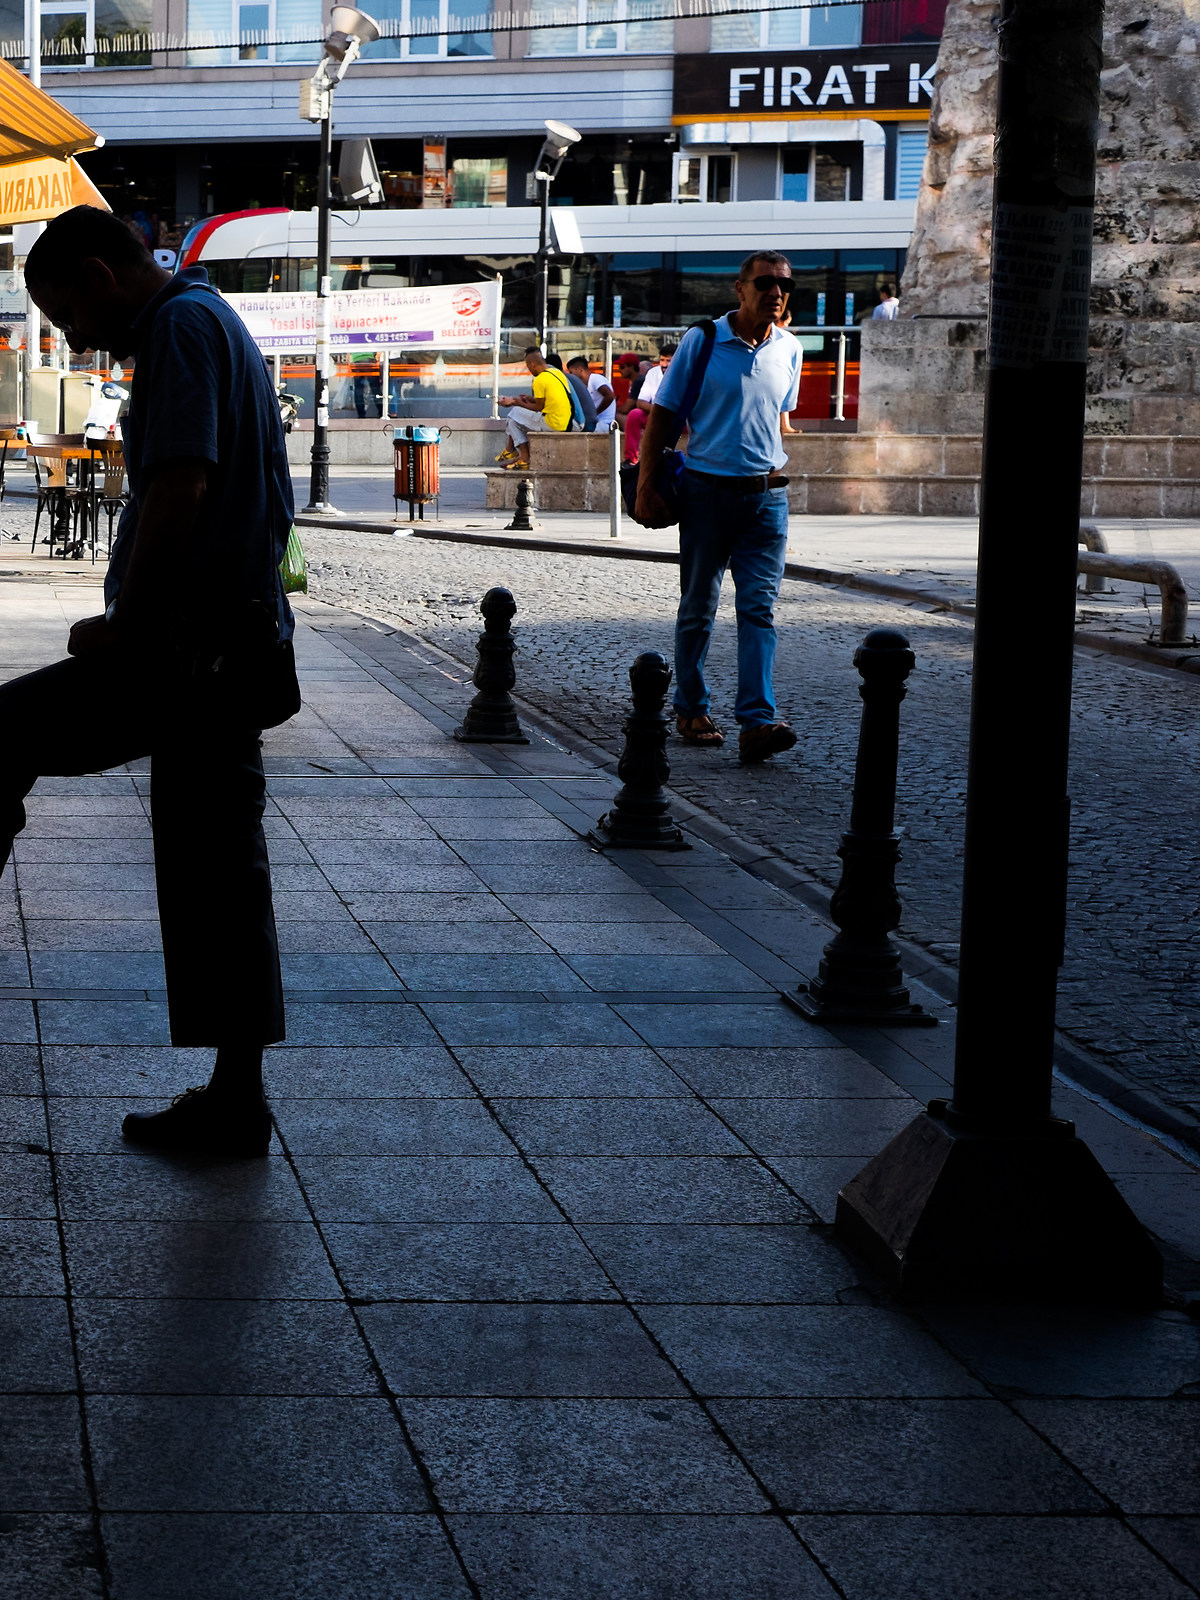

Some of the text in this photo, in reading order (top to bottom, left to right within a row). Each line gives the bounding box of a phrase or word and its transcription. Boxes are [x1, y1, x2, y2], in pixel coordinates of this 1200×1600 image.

[729, 63, 937, 107] FIRAT K
[240, 297, 296, 314] Hanutçuluk
[346, 293, 380, 307] Yerleri
[383, 292, 431, 306] Hakkında
[270, 317, 298, 331] Yasal
[441, 328, 492, 337] BELEDİYESİ
